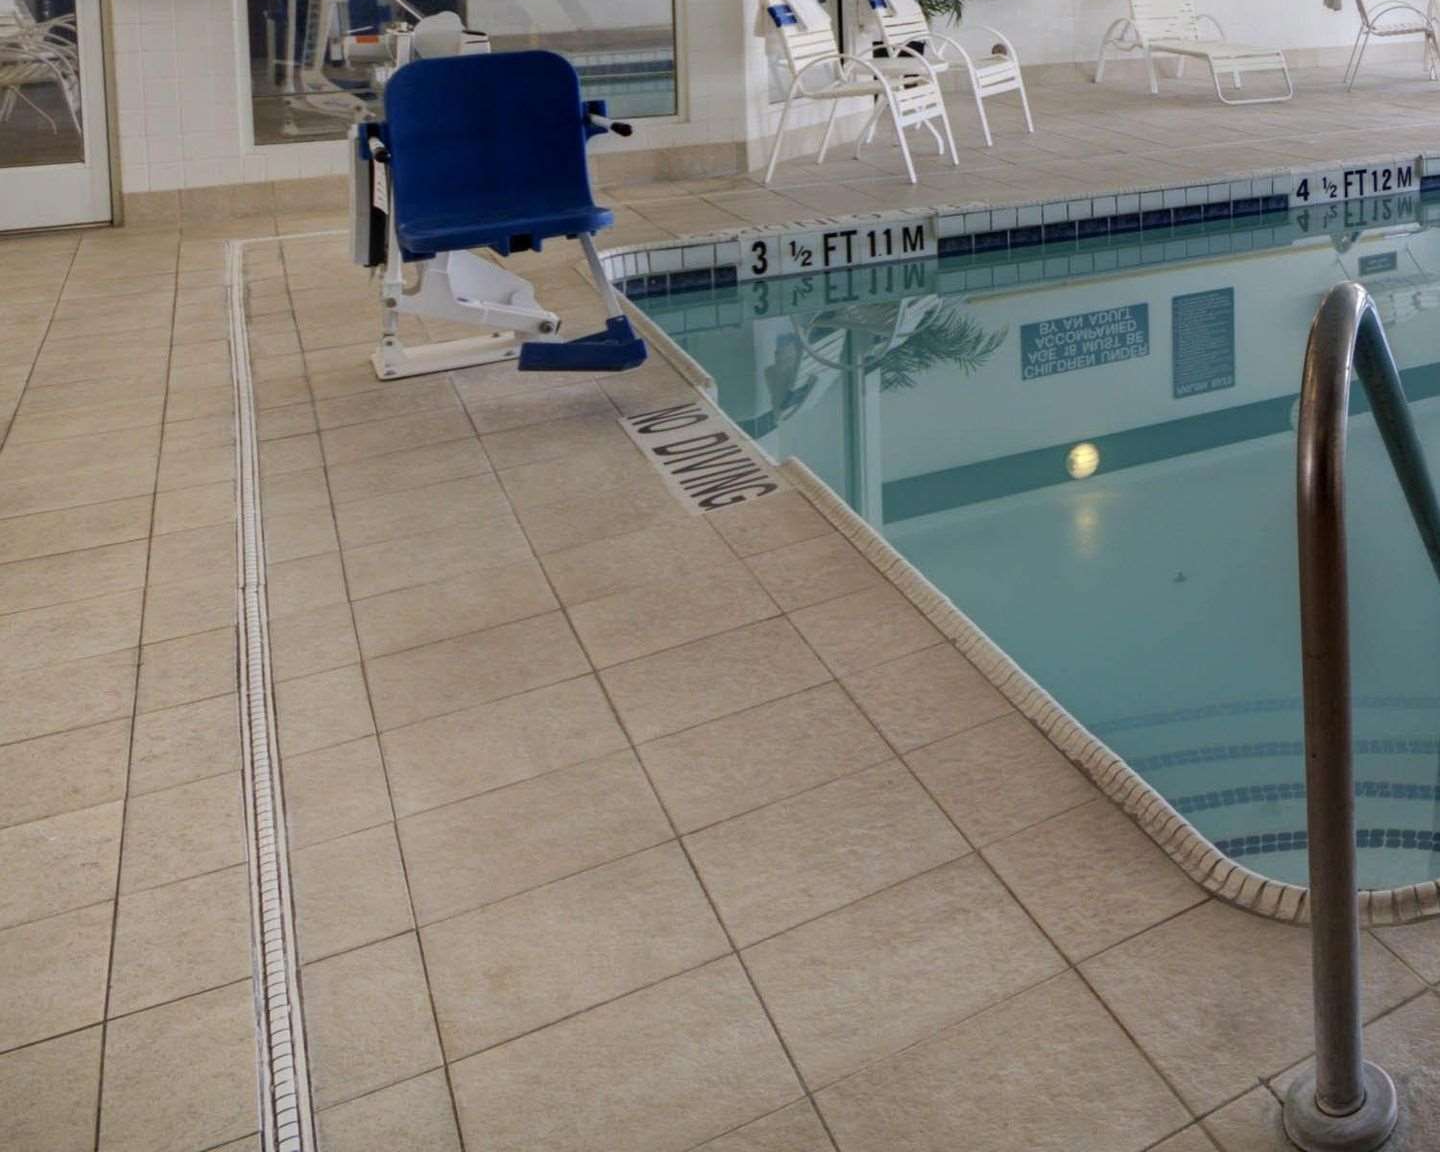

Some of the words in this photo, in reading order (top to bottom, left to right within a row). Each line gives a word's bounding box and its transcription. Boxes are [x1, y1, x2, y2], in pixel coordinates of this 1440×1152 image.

[1296, 177, 1310, 201] 4
[1344, 169, 1367, 198] FT
[1397, 166, 1412, 188] M
[752, 240, 768, 275] 3
[823, 230, 857, 266] FT
[902, 225, 924, 253] M
[626, 401, 709, 435] NO
[652, 431, 779, 512] DIVING
